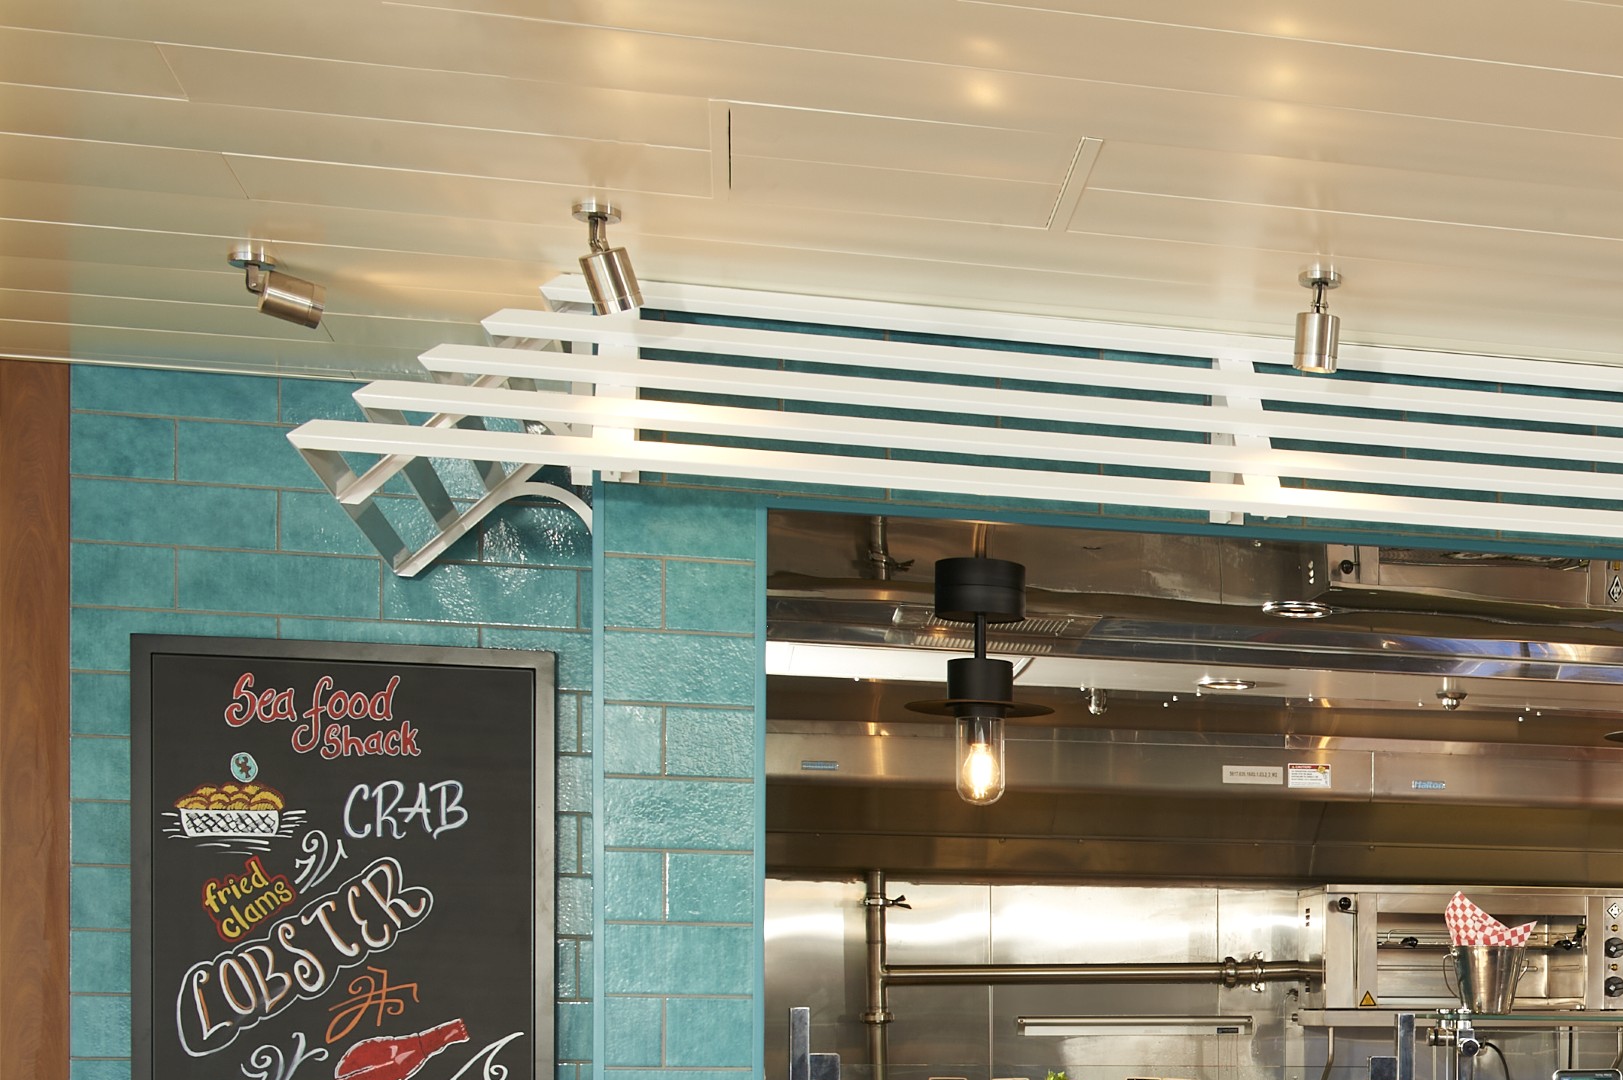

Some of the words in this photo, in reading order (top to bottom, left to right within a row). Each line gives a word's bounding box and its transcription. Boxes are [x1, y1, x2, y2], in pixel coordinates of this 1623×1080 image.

[343, 779, 470, 840] CRAB
[204, 861, 270, 914] fried
[221, 877, 294, 938] clams
[190, 862, 427, 1042] LOBSTER
